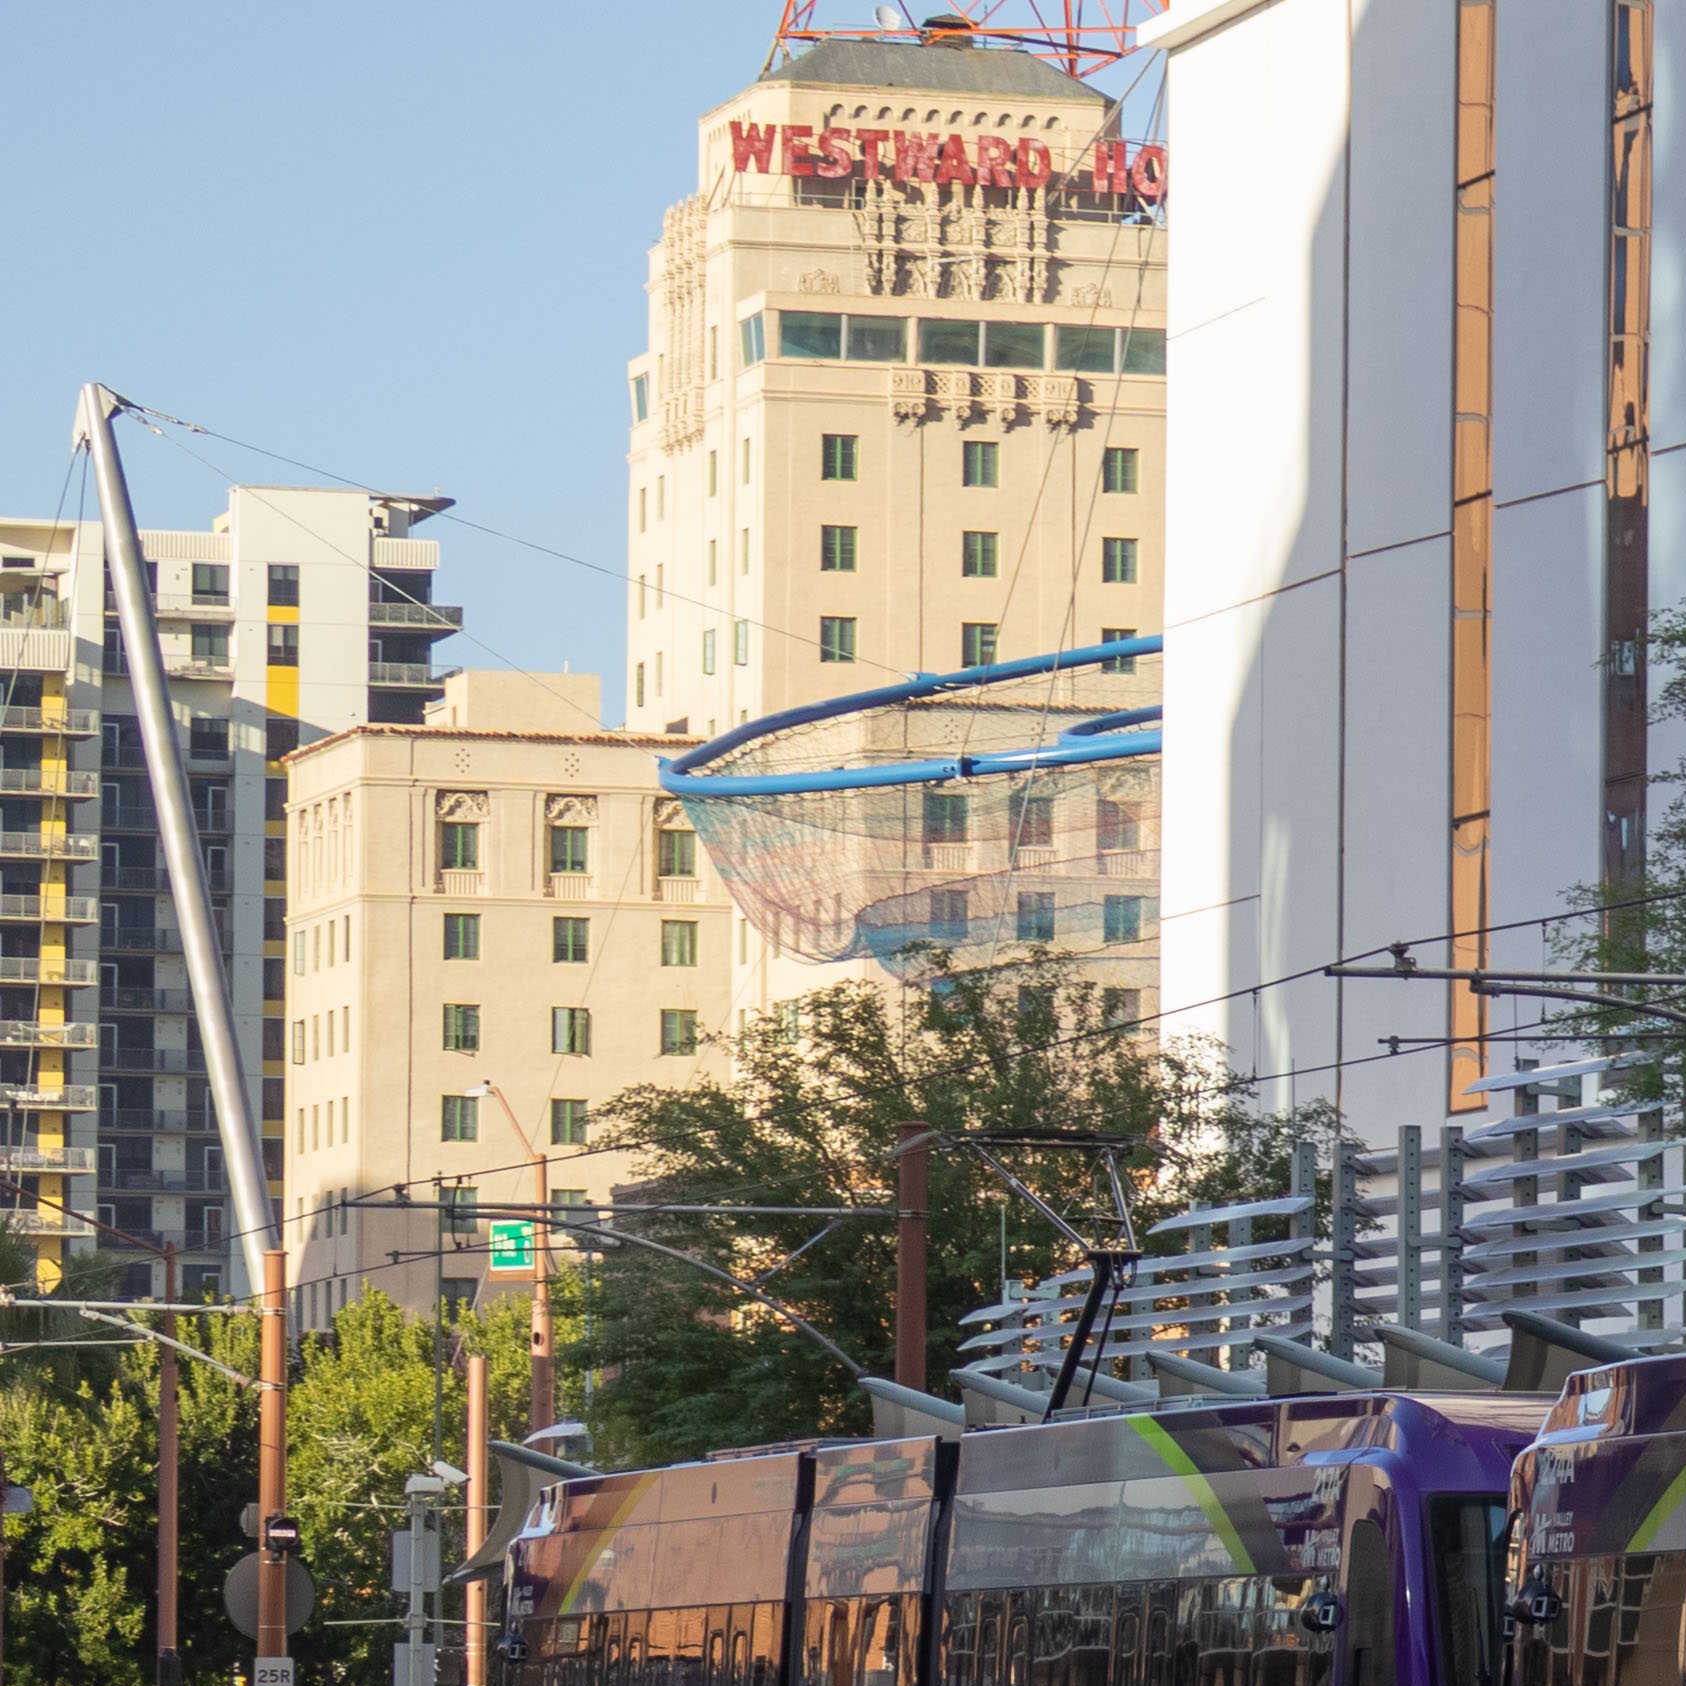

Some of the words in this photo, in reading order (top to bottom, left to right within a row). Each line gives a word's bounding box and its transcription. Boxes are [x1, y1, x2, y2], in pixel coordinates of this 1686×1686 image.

[729, 120, 1051, 188] WESTWARD
[1093, 139, 1167, 196] HO
[1546, 1531, 1575, 1553] METRO
[258, 1669, 290, 1683] 25R
